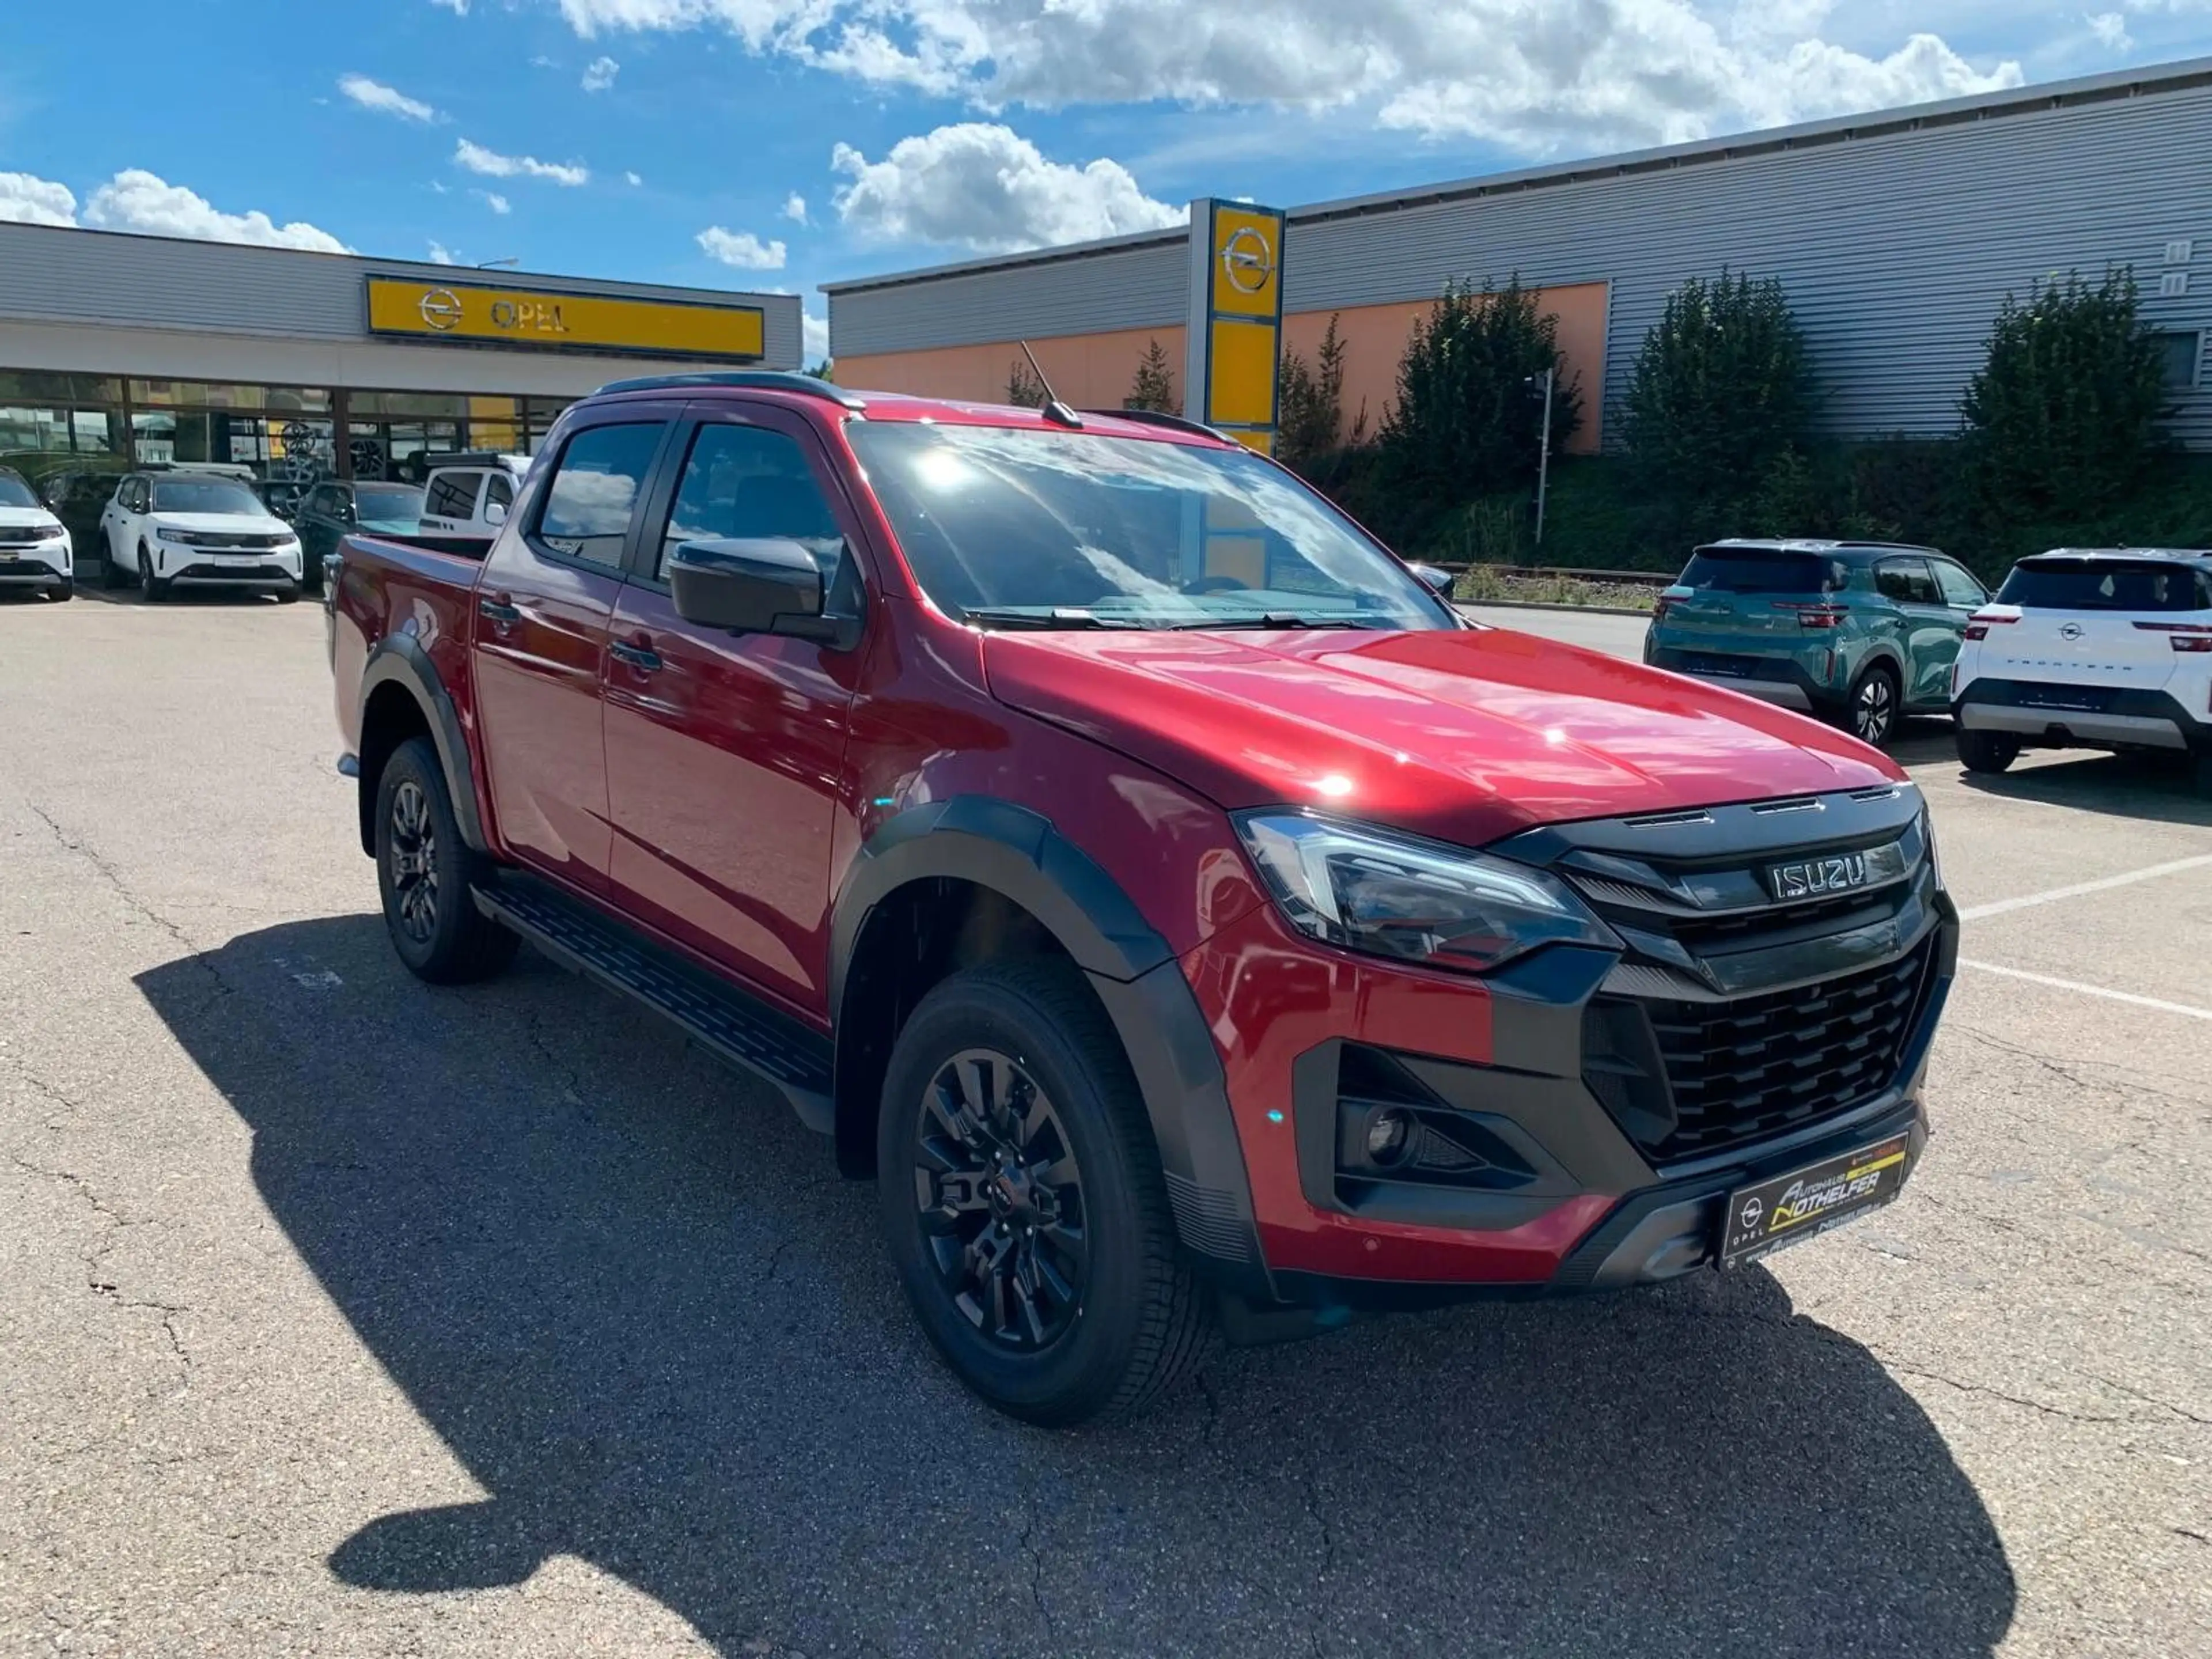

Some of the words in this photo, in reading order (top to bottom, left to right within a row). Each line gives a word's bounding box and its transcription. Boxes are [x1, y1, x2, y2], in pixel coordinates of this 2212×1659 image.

[491, 301, 570, 332] OPEL
[1774, 855, 1864, 899] ISUZU
[1771, 1171, 1881, 1225] NOTHELFER
[1733, 1229, 1764, 1245] OPEL
